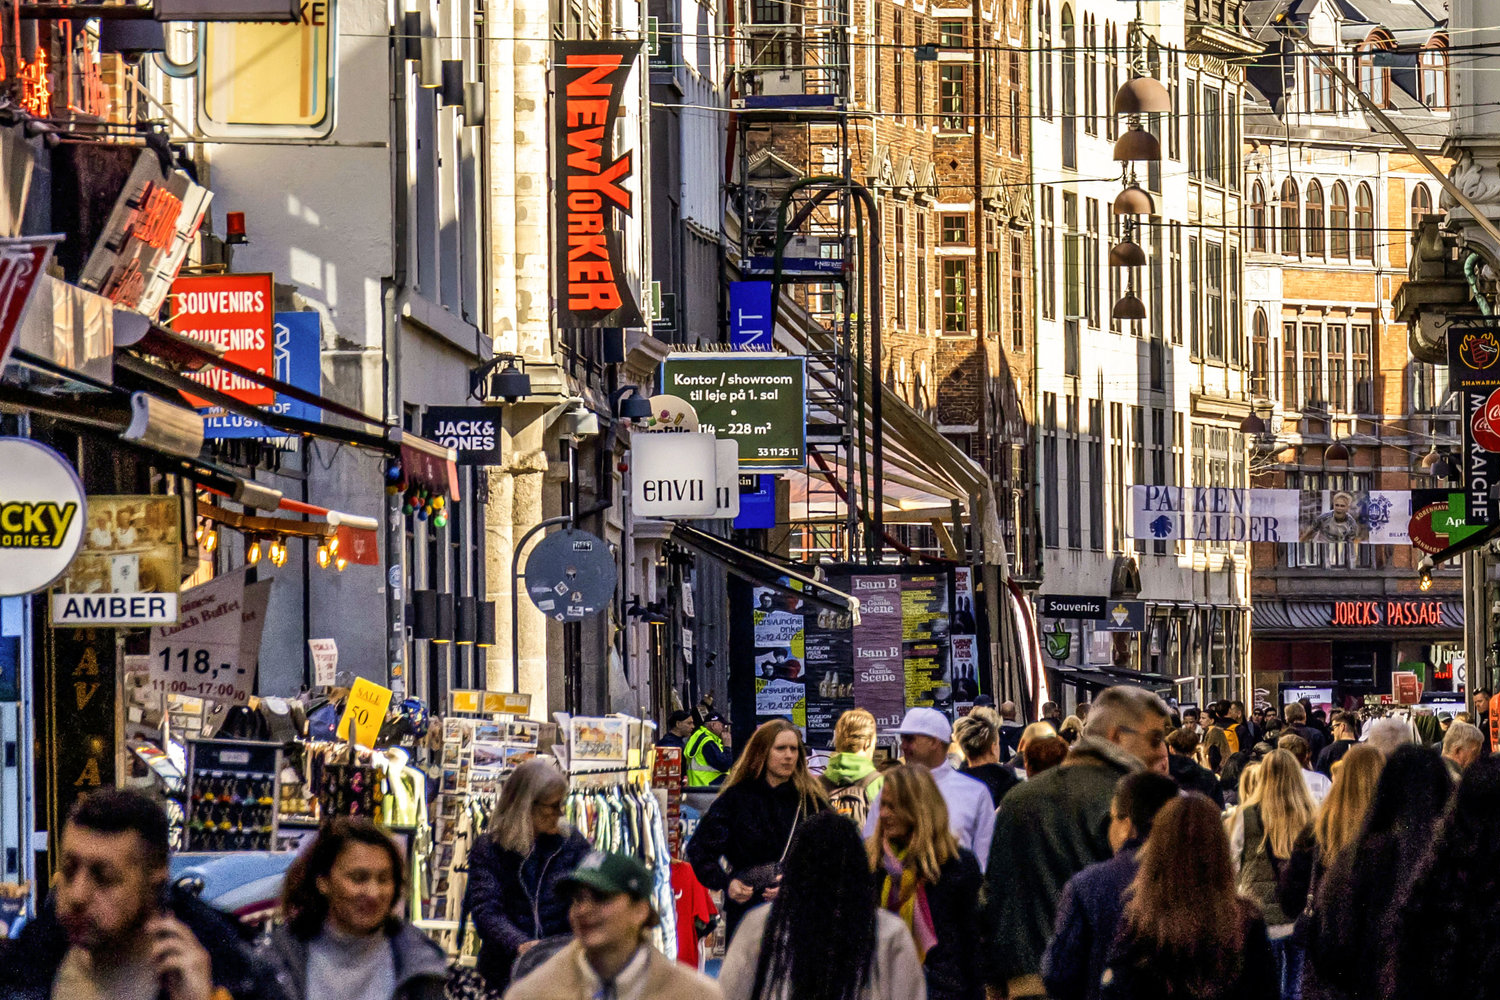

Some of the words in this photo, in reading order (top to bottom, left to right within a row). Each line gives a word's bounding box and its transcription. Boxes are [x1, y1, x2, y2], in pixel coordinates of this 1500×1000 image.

[178, 290, 265, 315] SOUVENIRS
[674, 373, 717, 386] Kontor
[720, 372, 726, 387] /
[727, 373, 793, 385] showroom
[1461, 379, 1500, 387] SHAWARMA
[690, 389, 702, 401] til
[705, 389, 727, 403] leje
[729, 388, 746, 403] på
[748, 389, 758, 400] 1.
[760, 388, 778, 400] sal
[272, 402, 291, 414] OF
[435, 421, 495, 436] JACK&
[728, 423, 752, 435] 228
[754, 422, 772, 435] m²
[757, 447, 768, 456] 33
[770, 447, 778, 456] 11
[778, 447, 789, 456] 25
[791, 447, 799, 456] 11
[0, 502, 76, 547] CKY
[856, 579, 886, 590] Isam
[888, 578, 897, 589] B
[62, 597, 167, 619] AMBER
[200, 600, 240, 623] Buffet
[860, 604, 894, 614] Scene
[1050, 601, 1100, 613] Souvenirs
[1331, 601, 1380, 625] JORCKS
[1387, 601, 1444, 625] PASSAGE
[857, 648, 888, 658] Isam
[890, 646, 899, 657] B
[860, 673, 896, 683] Scene
[358, 686, 381, 706] SALE
